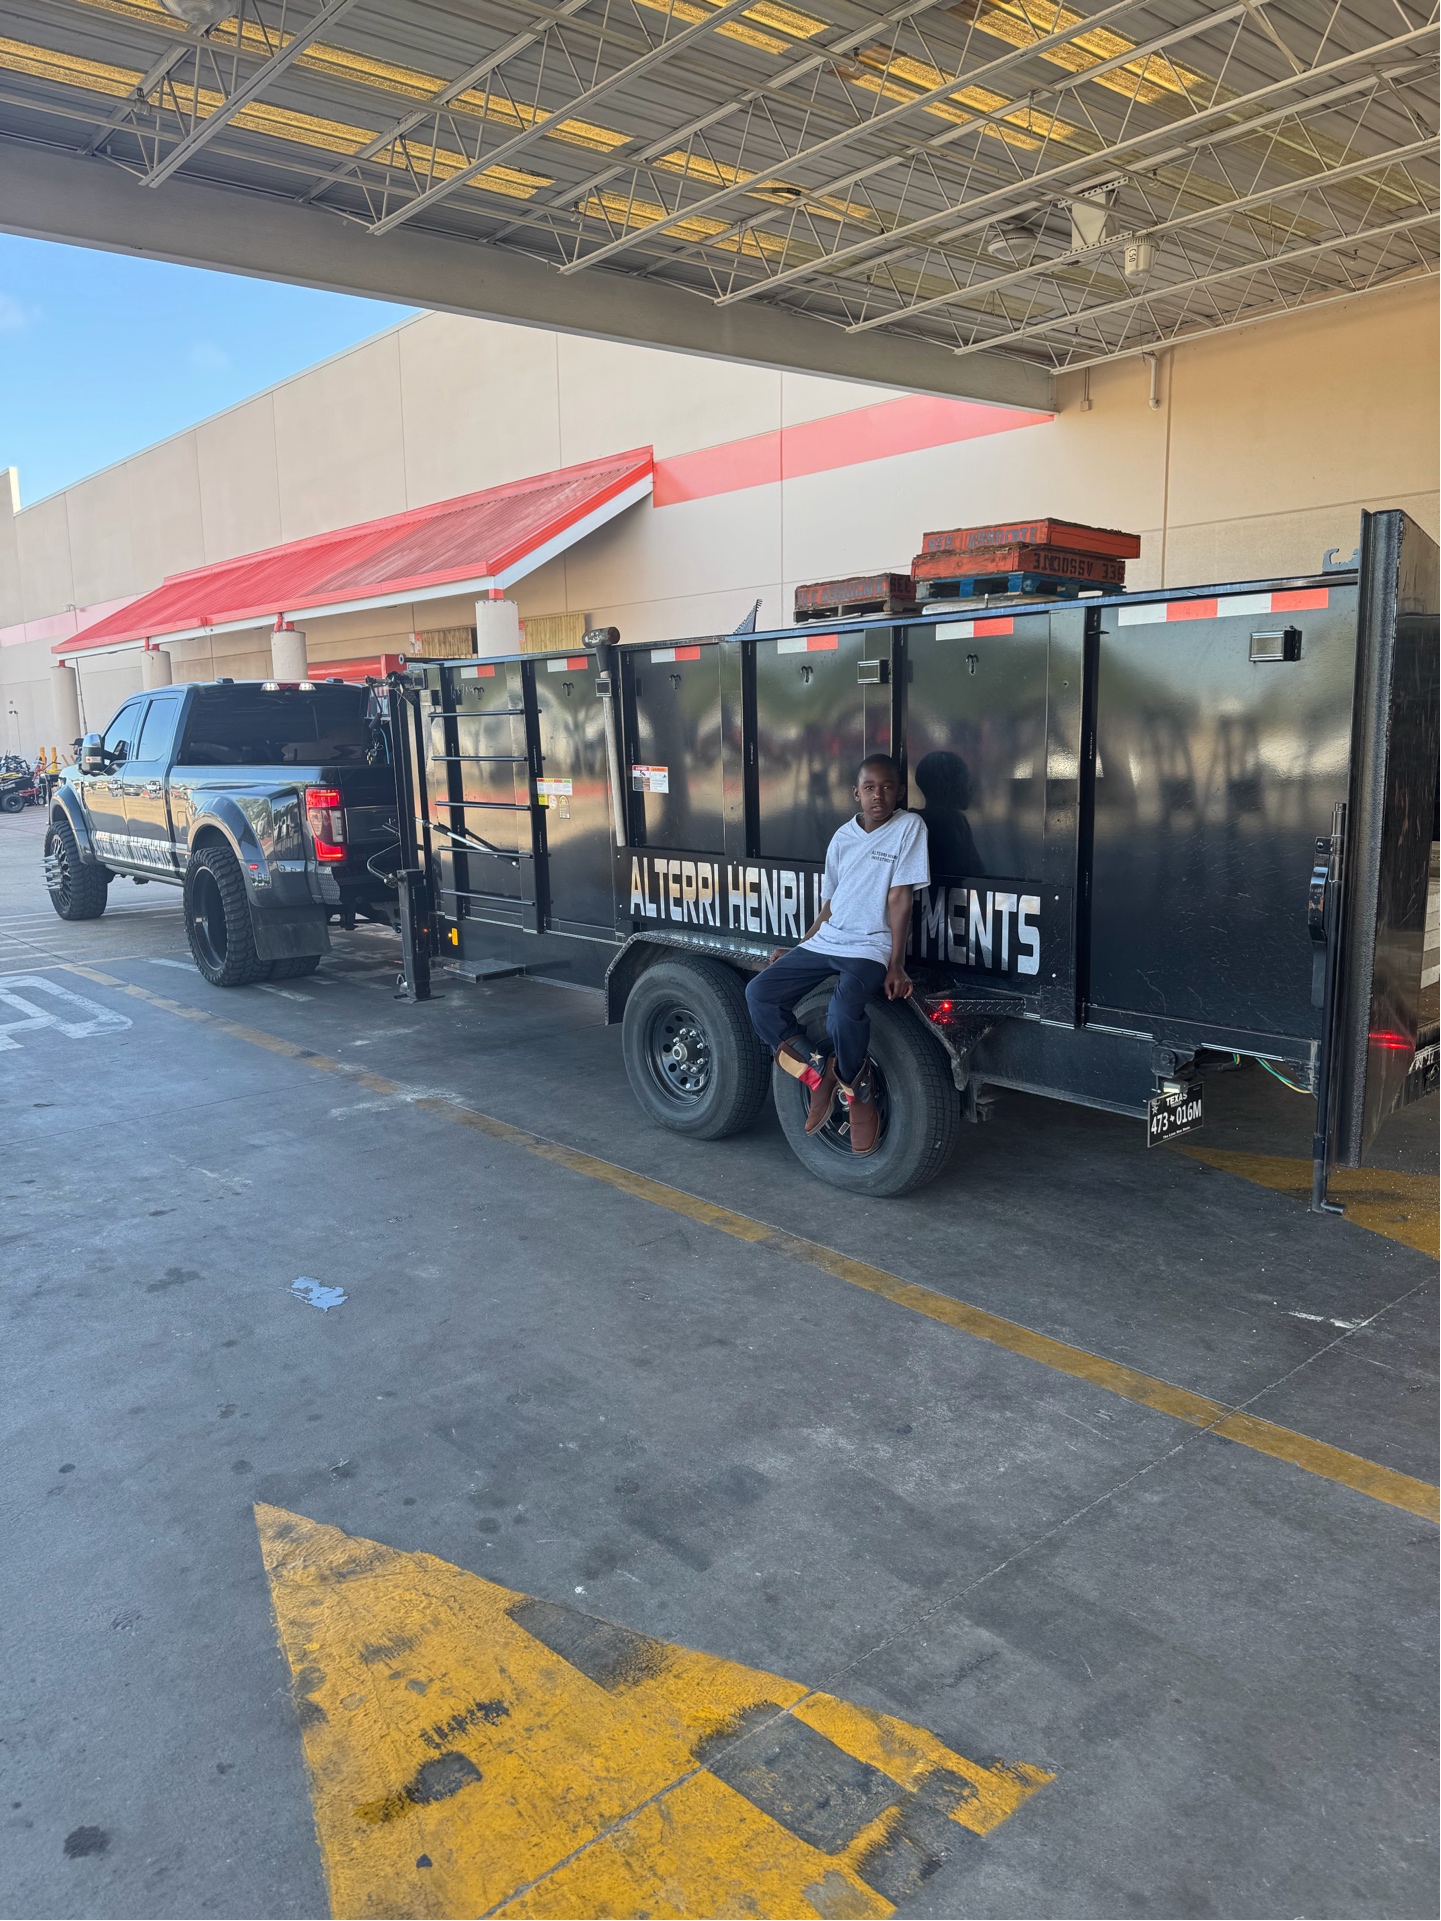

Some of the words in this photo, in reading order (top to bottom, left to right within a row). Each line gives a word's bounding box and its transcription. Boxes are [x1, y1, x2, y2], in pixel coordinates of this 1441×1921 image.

[629, 855, 721, 927] ALTERRI
[727, 864, 806, 940] HENRI
[1151, 1112, 1168, 1134] 473
[1176, 1099, 1201, 1125] 016M
[1166, 1093, 1187, 1106] TEXAS
